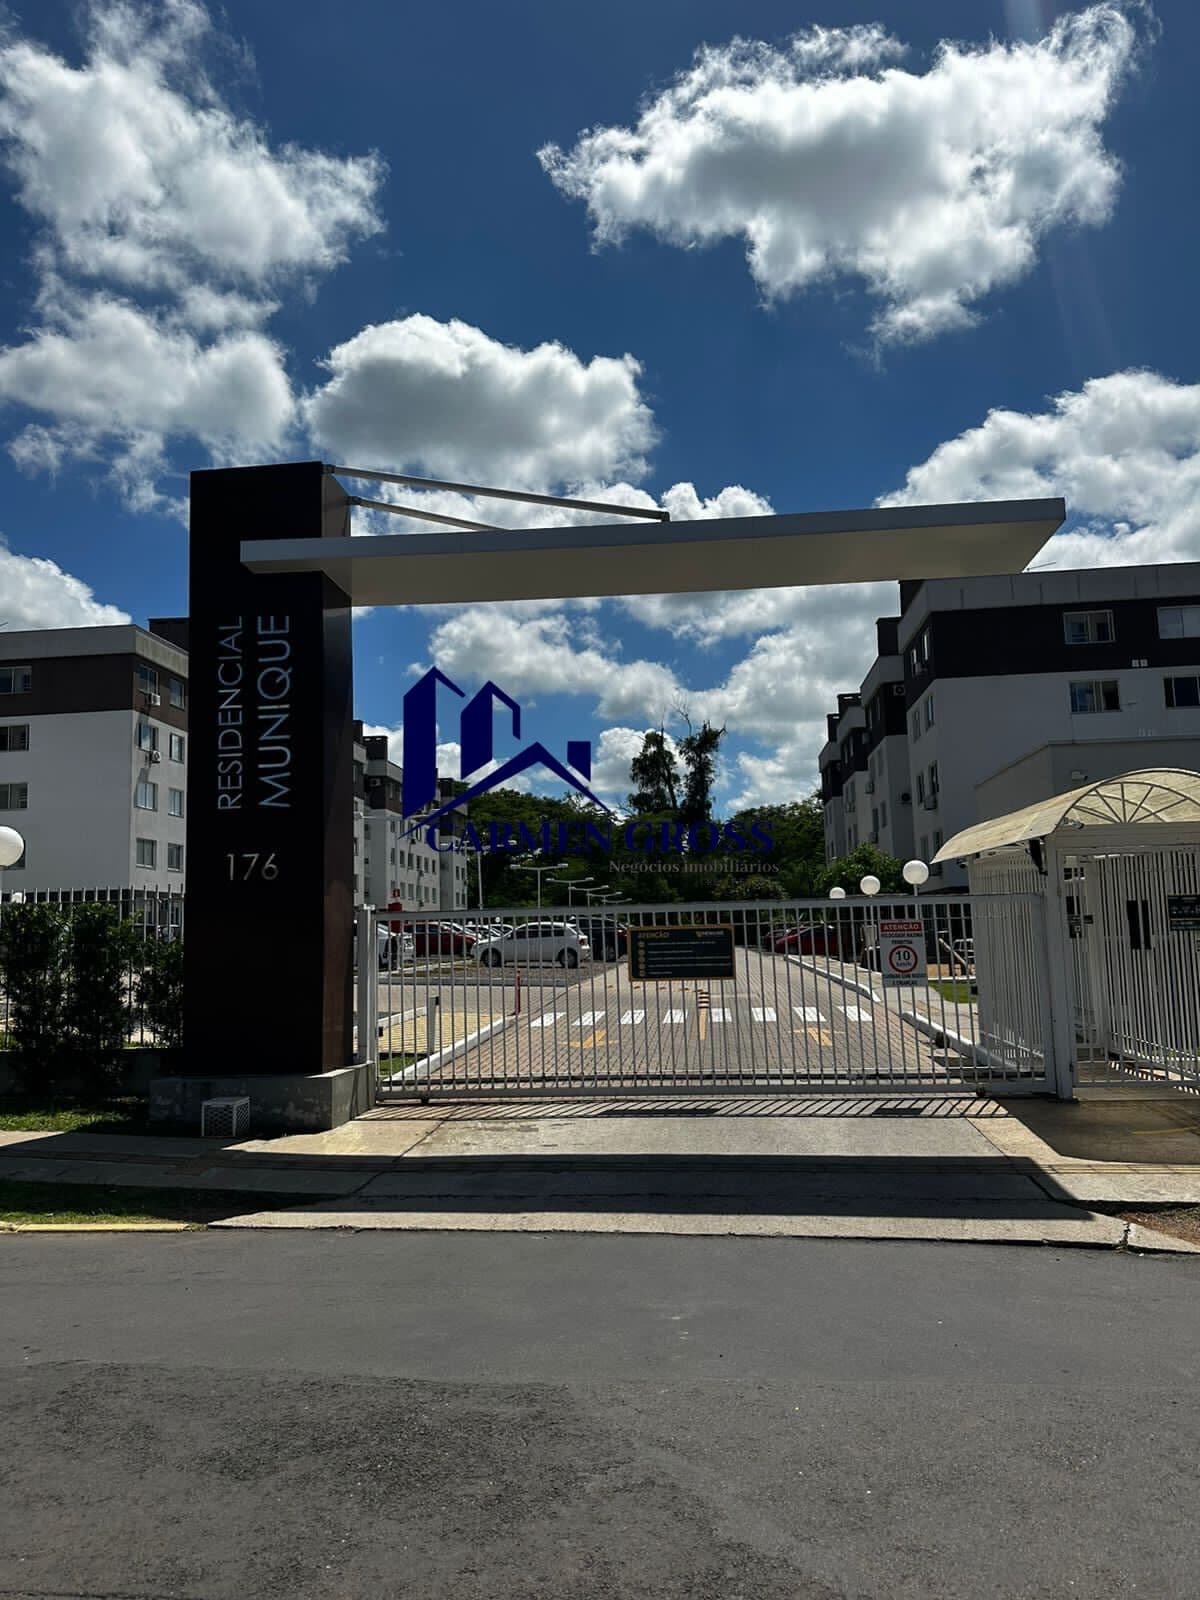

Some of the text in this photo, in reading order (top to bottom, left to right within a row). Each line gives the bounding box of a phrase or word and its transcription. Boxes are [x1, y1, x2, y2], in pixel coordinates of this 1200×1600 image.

[217, 615, 243, 810] RESIDENCIAL
[256, 615, 293, 808] MUNIQUE
[226, 852, 279, 881] 176
[896, 950, 911, 961] 10
